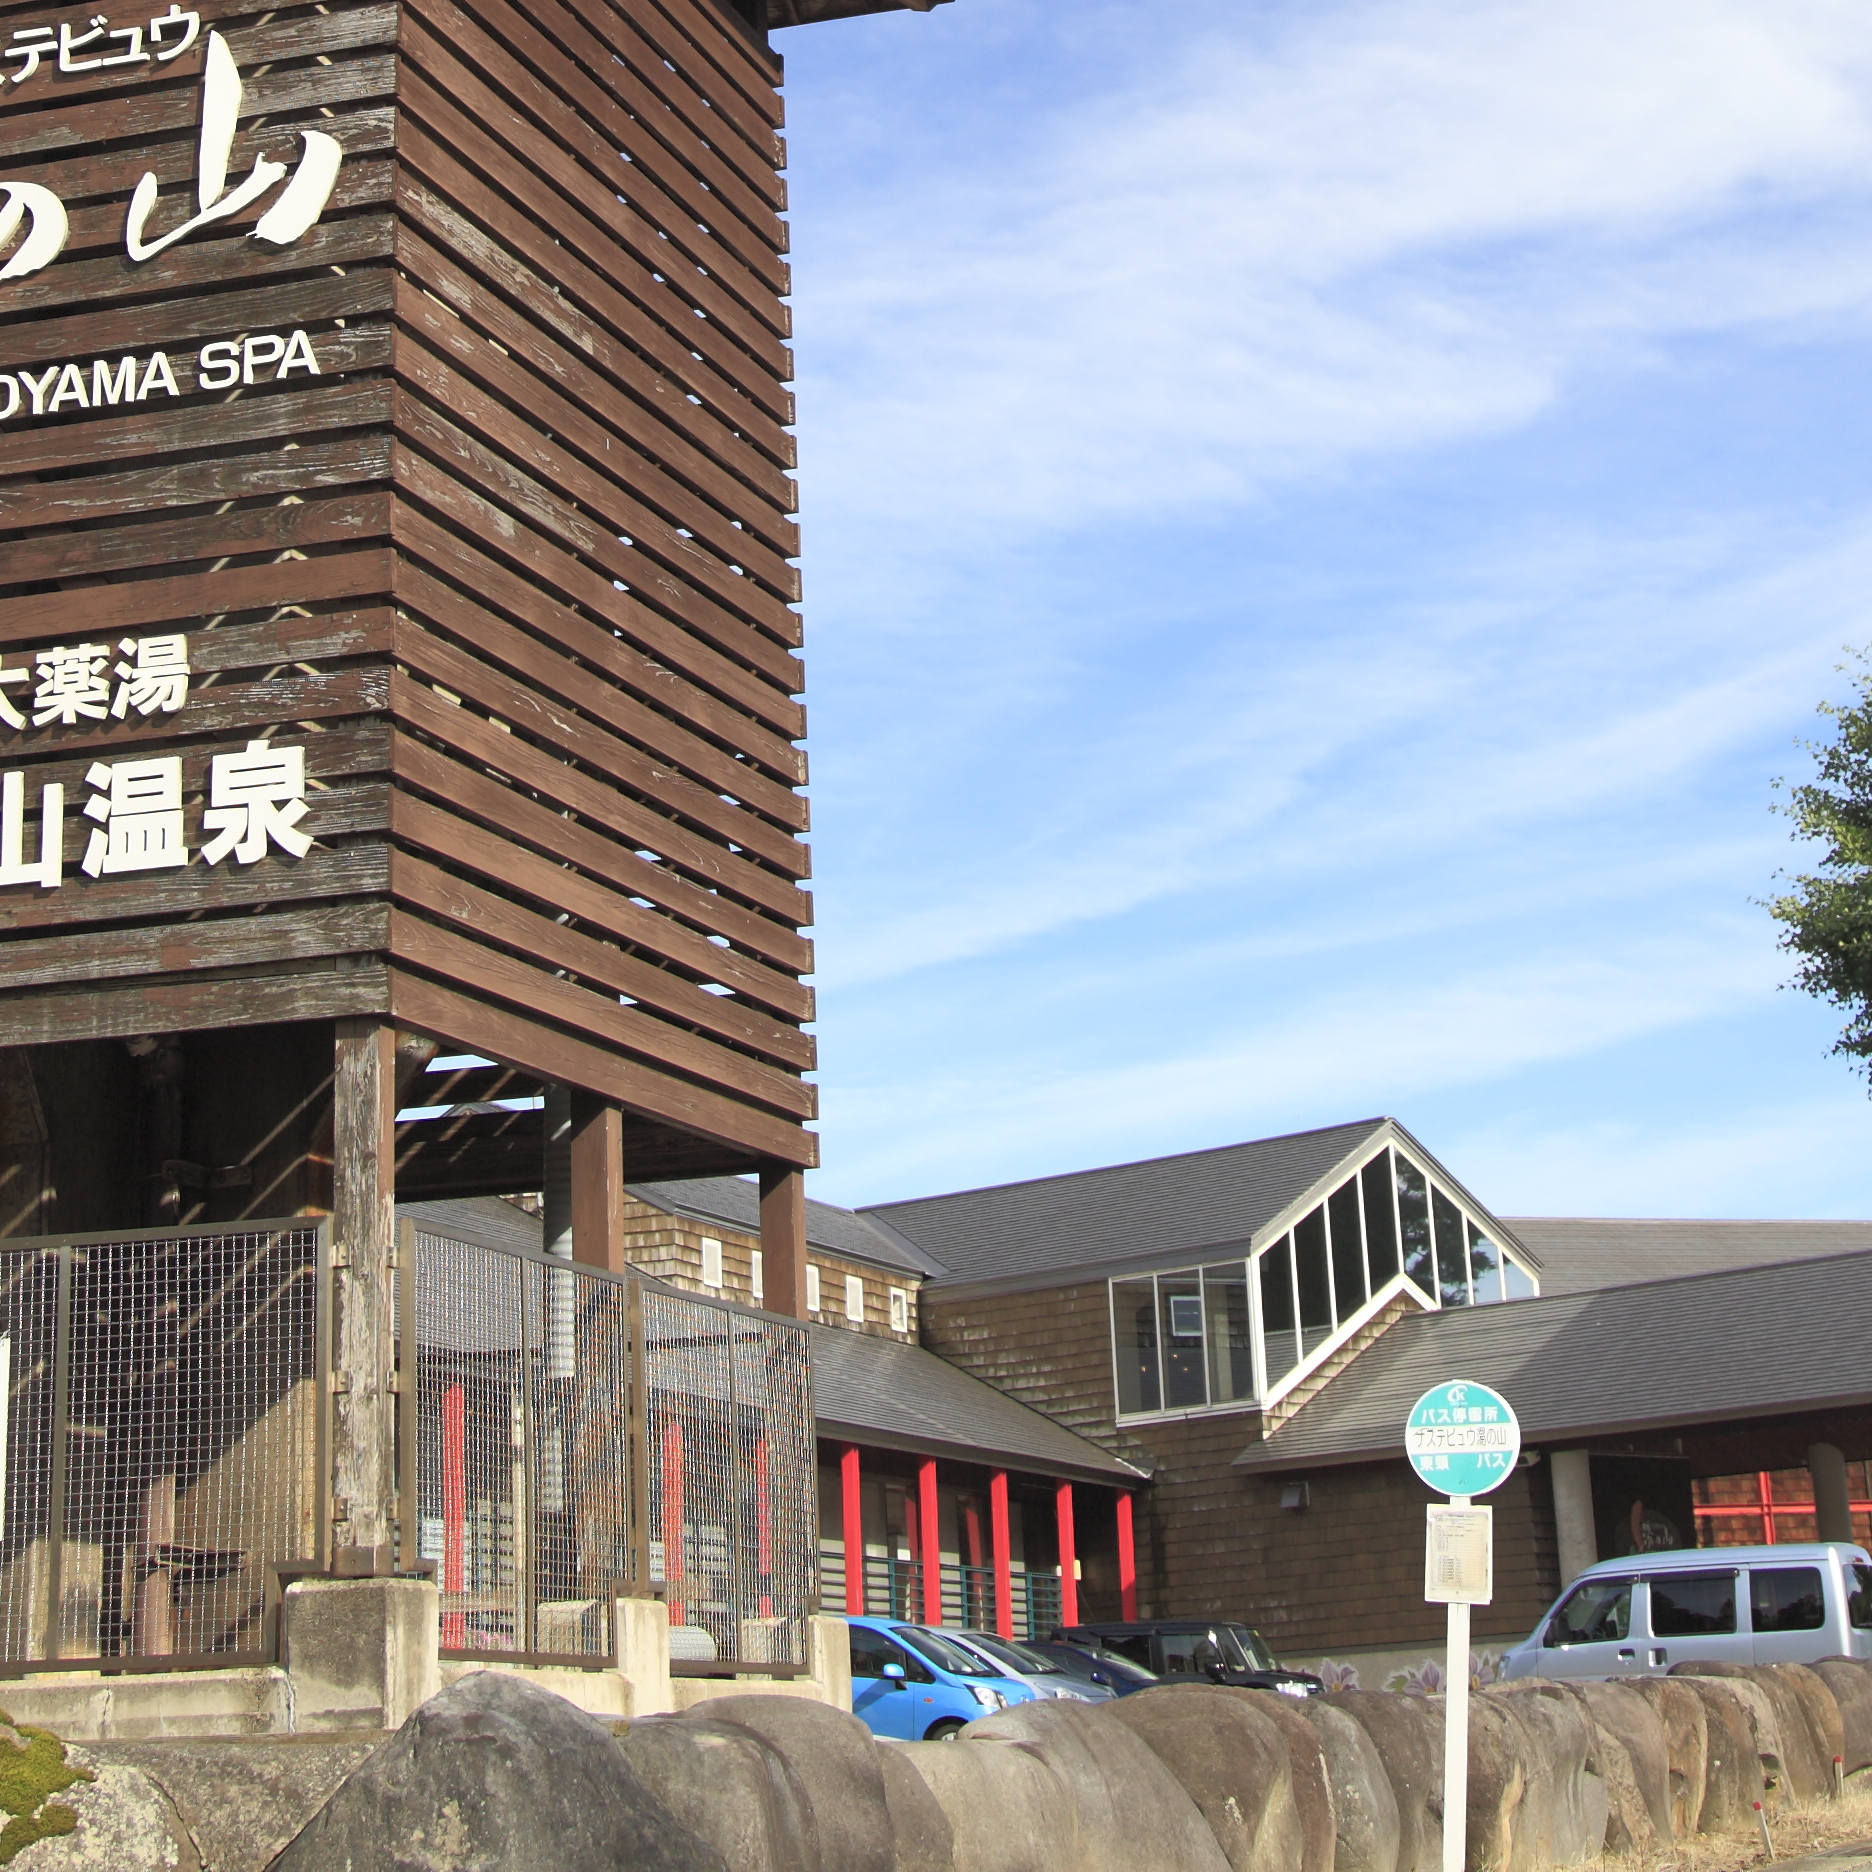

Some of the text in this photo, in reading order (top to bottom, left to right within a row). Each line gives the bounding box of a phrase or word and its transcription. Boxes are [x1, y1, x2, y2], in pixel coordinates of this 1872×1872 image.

[199, 329, 322, 391] SPA
[1421, 1406, 1498, 1424] バス停留所
